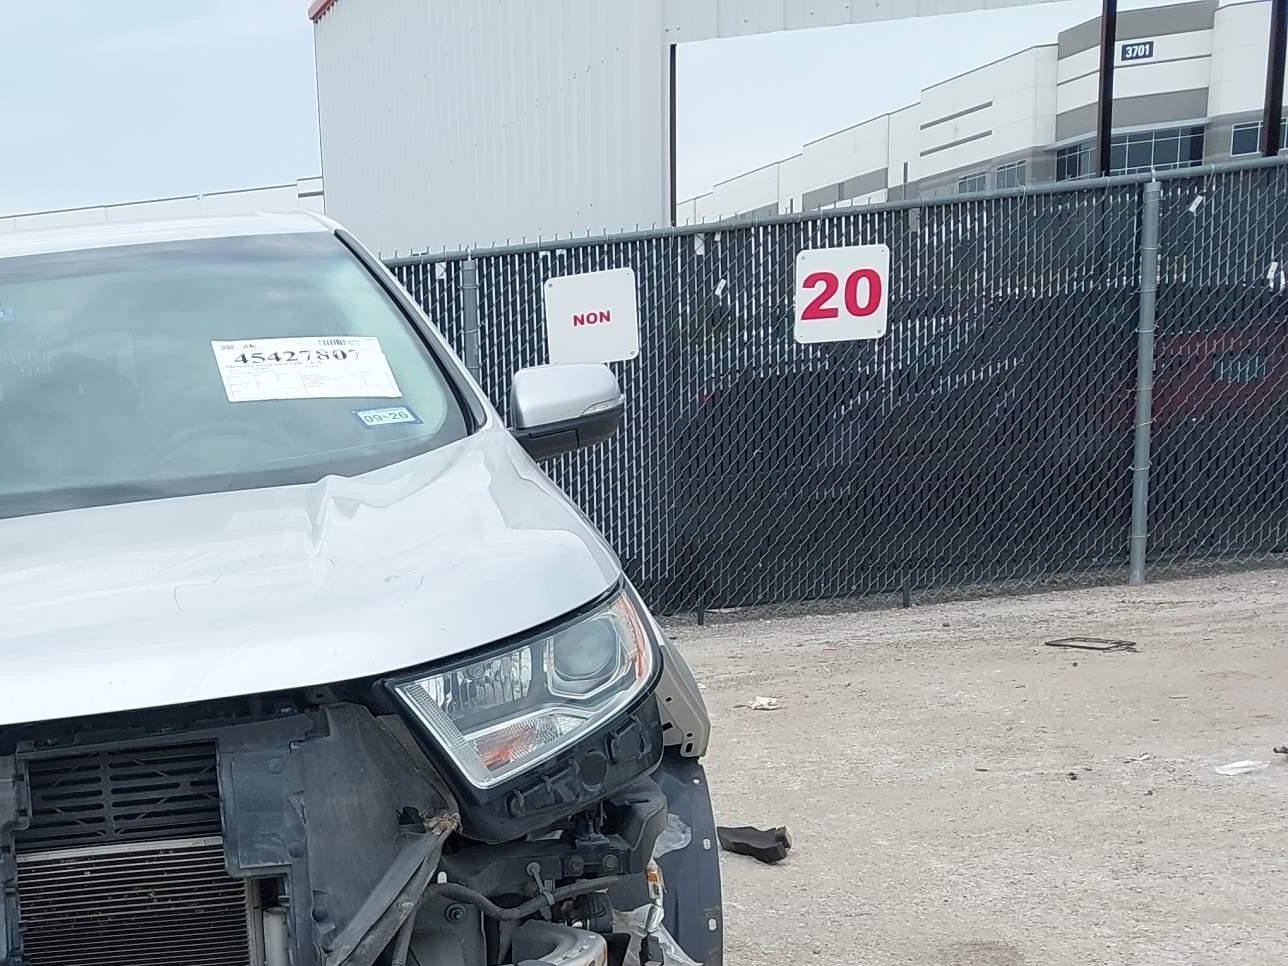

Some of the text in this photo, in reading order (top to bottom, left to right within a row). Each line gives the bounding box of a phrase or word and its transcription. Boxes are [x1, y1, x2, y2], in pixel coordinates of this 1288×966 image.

[1125, 43, 1150, 58] 3701
[801, 268, 882, 321] 20
[573, 310, 611, 327] NON
[234, 349, 360, 364] 45427807
